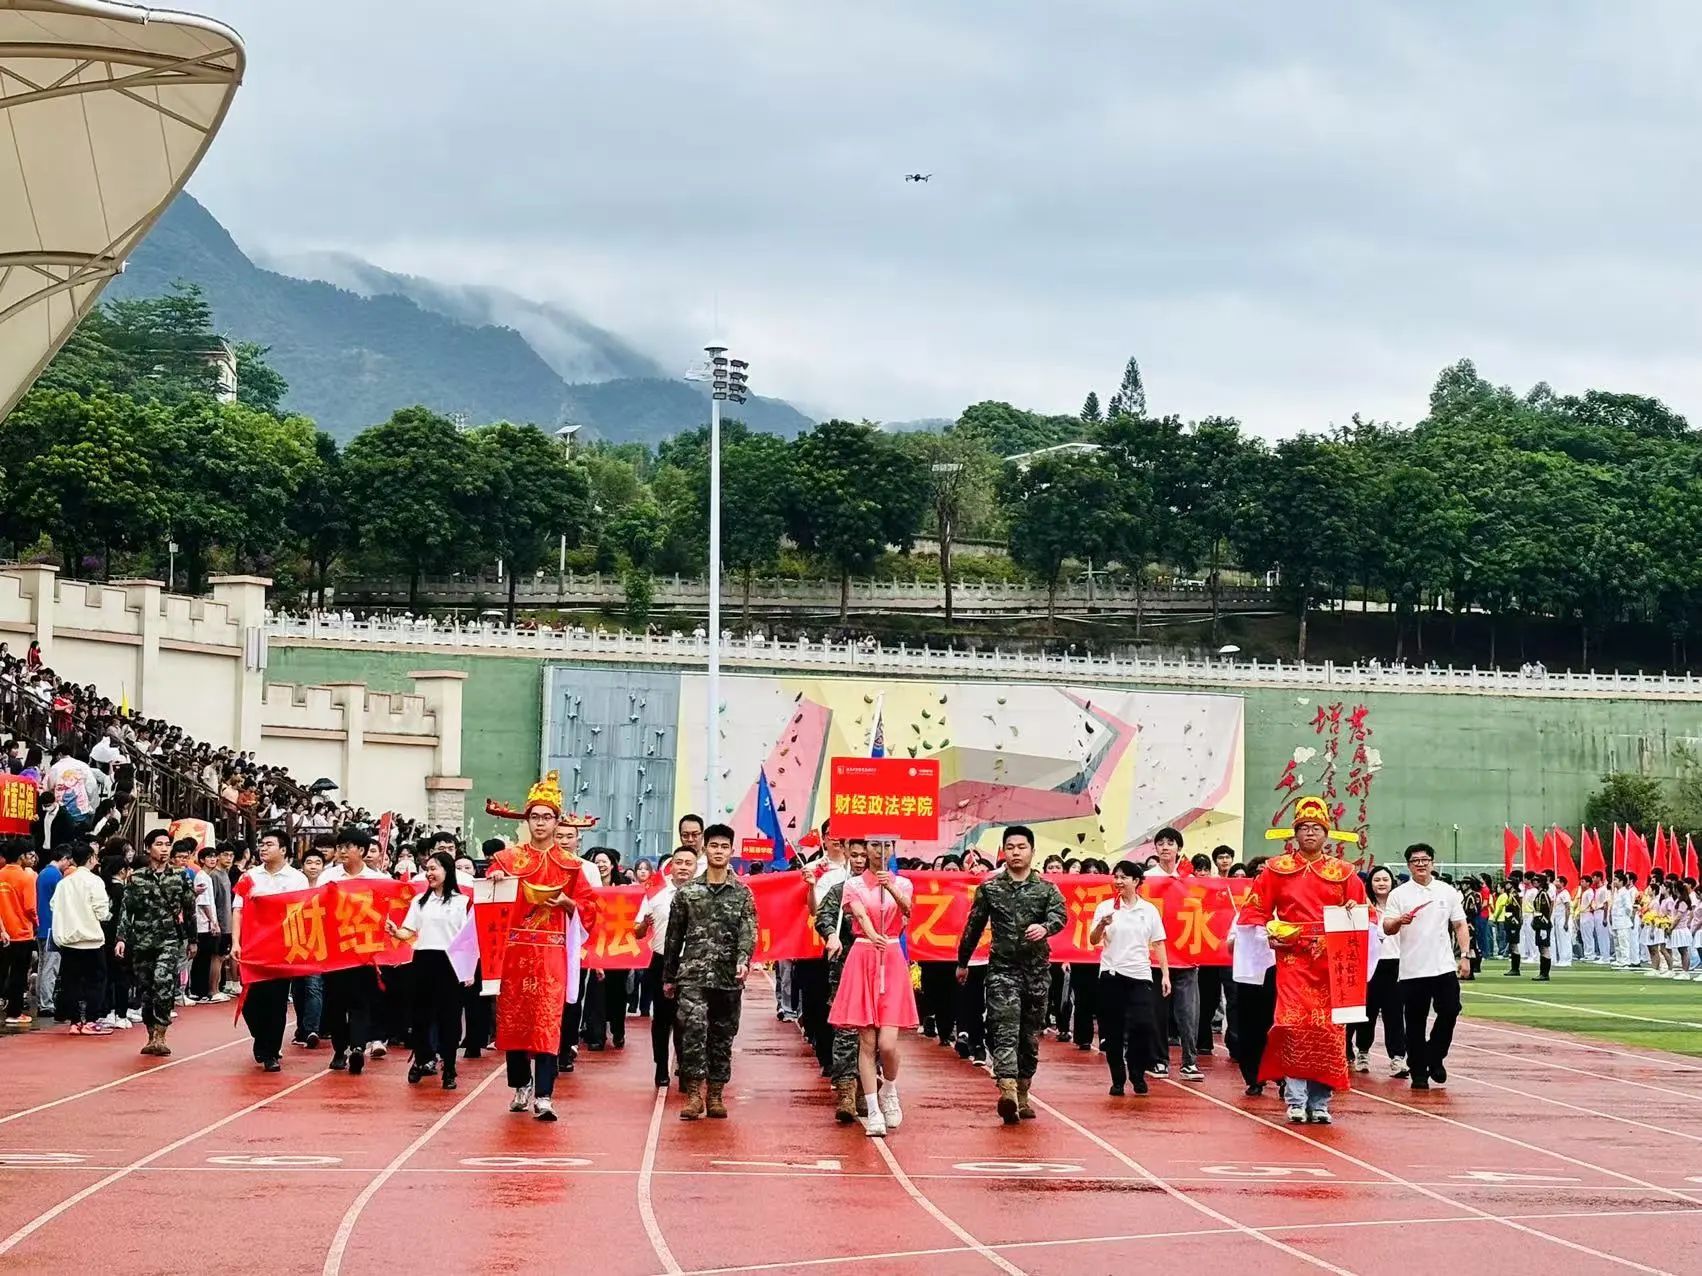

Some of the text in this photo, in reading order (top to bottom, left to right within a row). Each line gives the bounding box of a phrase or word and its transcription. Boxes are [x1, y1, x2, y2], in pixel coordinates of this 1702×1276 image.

[835, 794, 933, 816] 财经政法学院
[458, 1156, 594, 1166] 8
